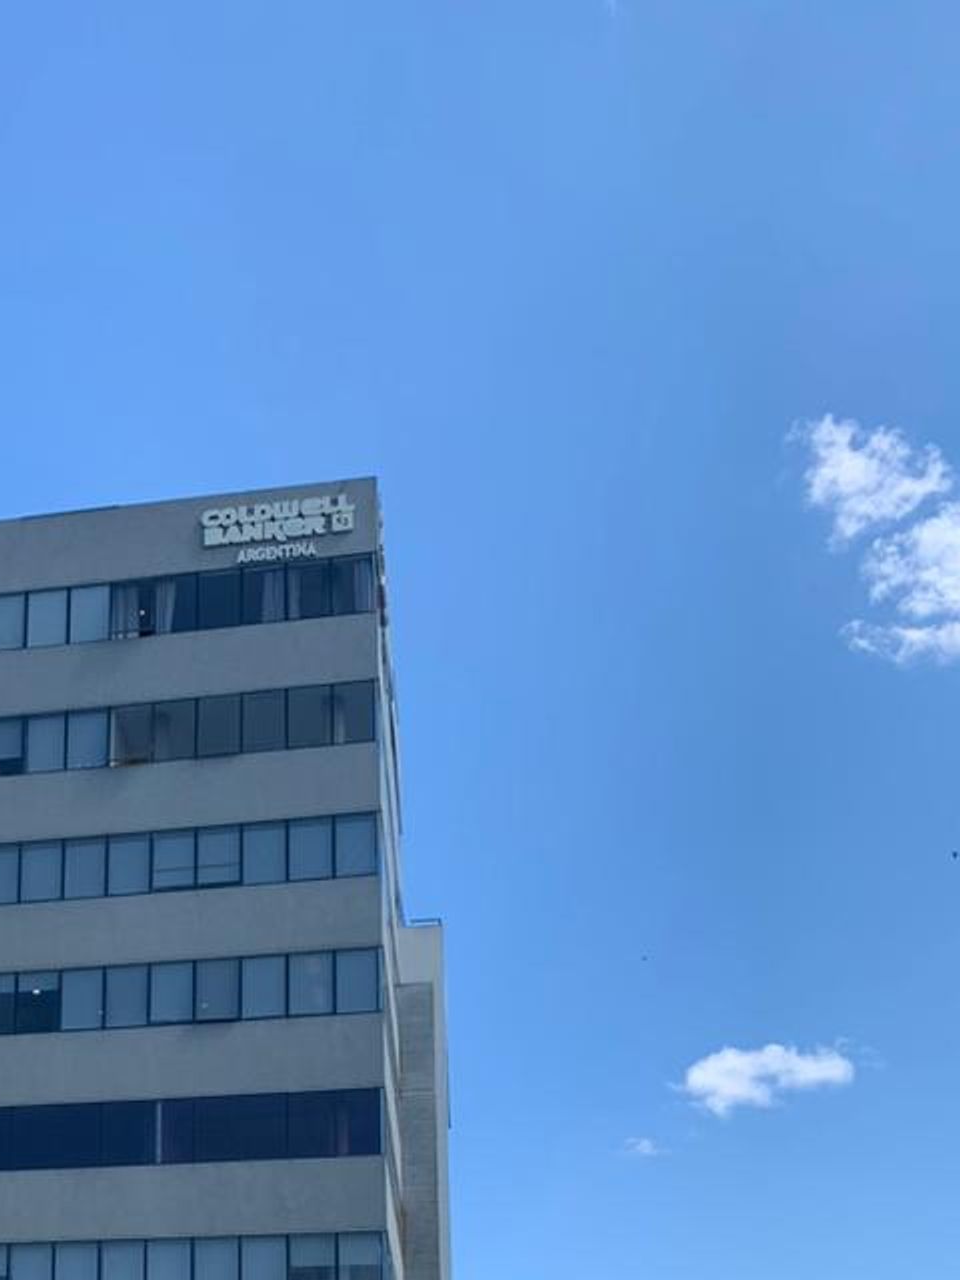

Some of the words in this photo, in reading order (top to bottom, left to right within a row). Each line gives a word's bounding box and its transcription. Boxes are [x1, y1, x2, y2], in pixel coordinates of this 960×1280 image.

[202, 494, 355, 527] COLDWELL
[204, 515, 326, 546] BANKER
[236, 541, 317, 563] ARGENTINA
